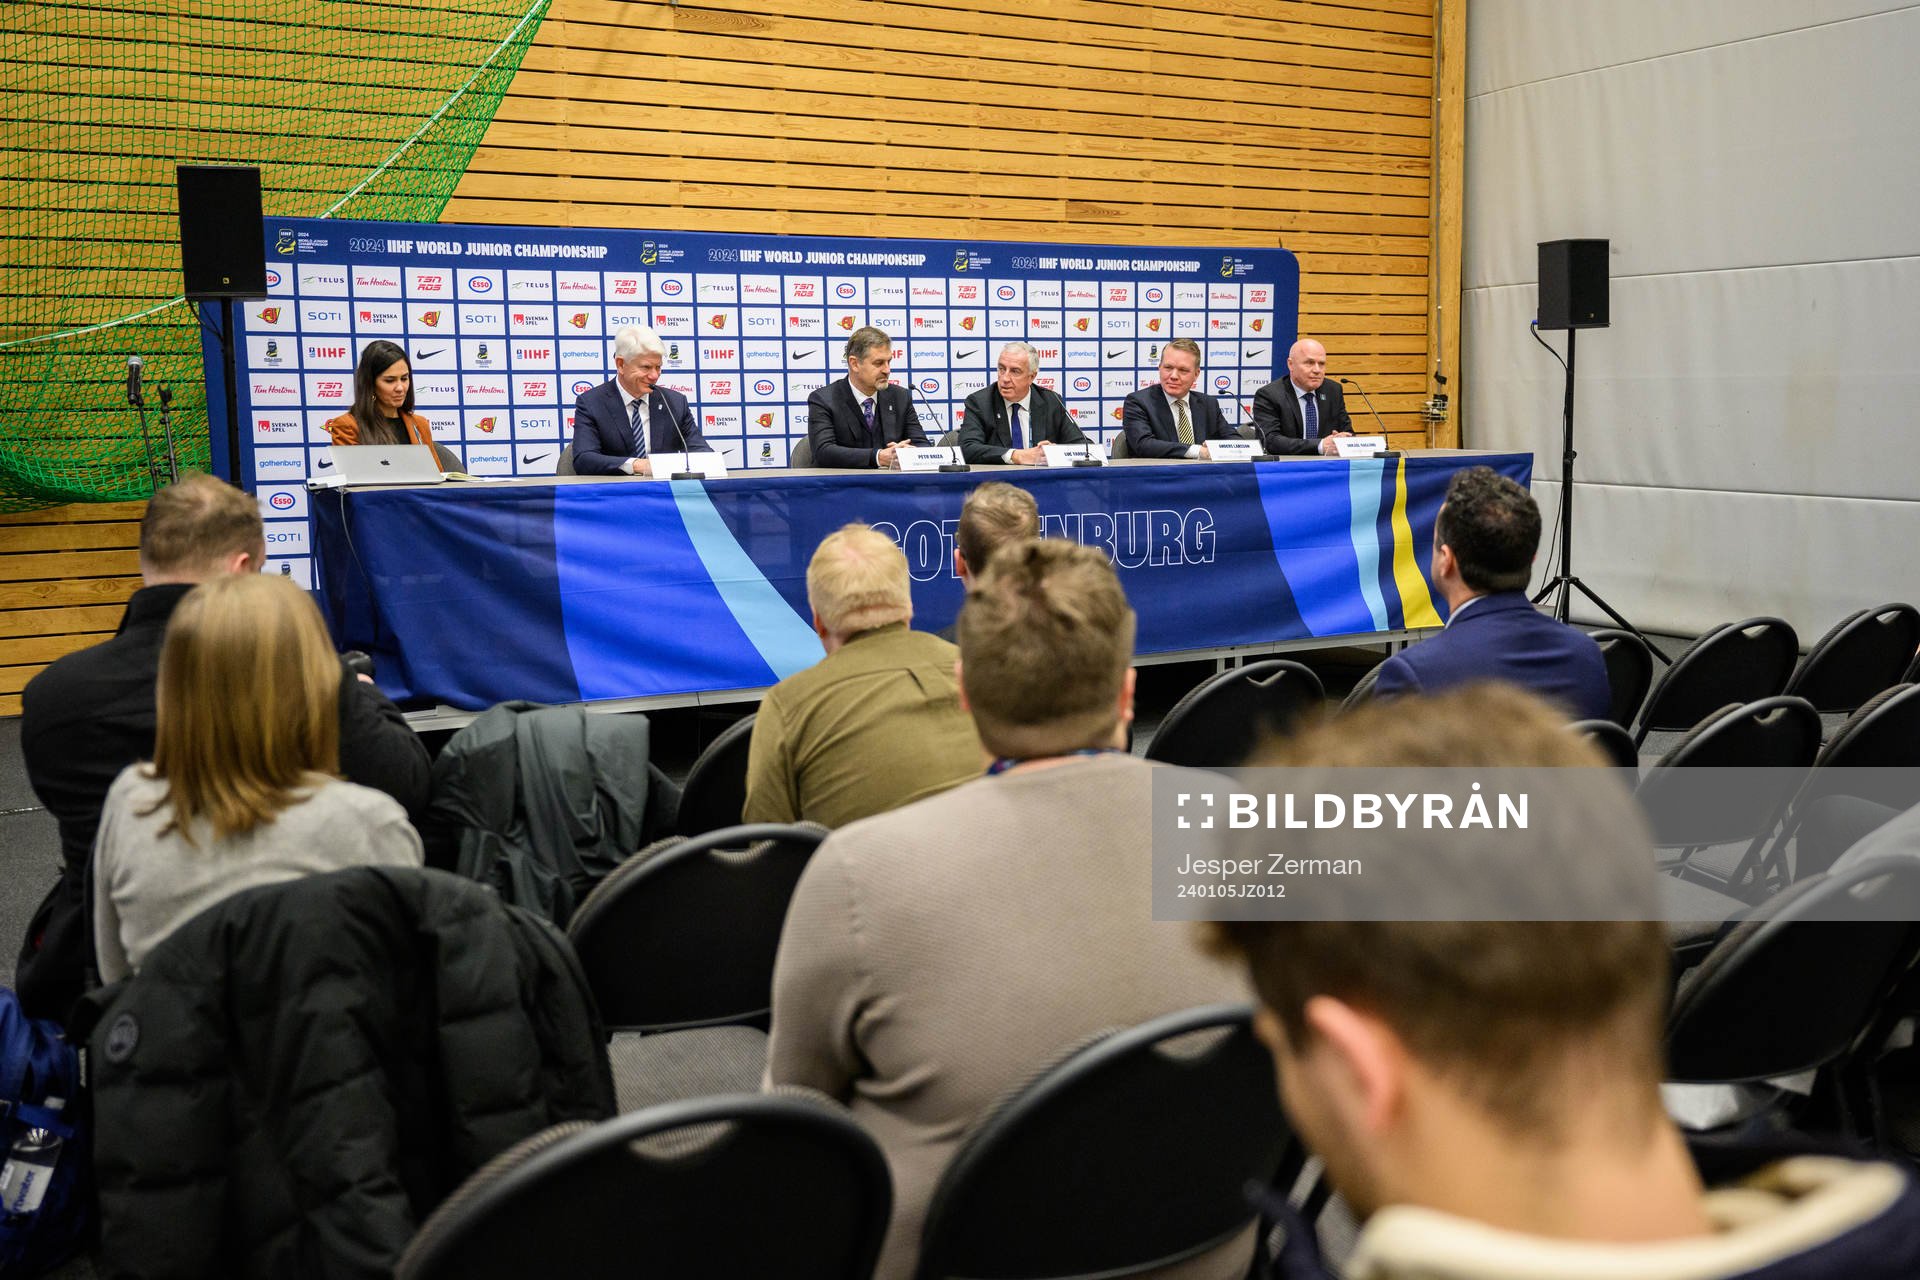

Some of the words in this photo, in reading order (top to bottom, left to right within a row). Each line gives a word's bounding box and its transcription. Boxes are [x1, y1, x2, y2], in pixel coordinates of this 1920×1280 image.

[350, 239, 384, 252] 2024
[387, 240, 412, 254] IIHF
[416, 241, 462, 255] WORLD
[465, 242, 512, 256] JUNIOR
[515, 243, 608, 259] CHAMPIONSHIP
[709, 250, 738, 261] 2024
[740, 250, 761, 262] IIHF
[764, 251, 802, 263] WORLD
[806, 252, 844, 264] JUNIOR
[847, 254, 926, 266] CHAMPIONSHIP
[1012, 257, 1037, 269] 2024
[1039, 258, 1057, 269] IIHF
[1060, 259, 1093, 269] WORLD
[1096, 260, 1129, 270] JUNIOR
[1131, 260, 1200, 271] CHAMPIONSHIP
[356, 277, 368, 286] Tim
[370, 278, 397, 286] Hortons
[560, 282, 570, 290] Tim
[755, 285, 777, 293] Hortons
[308, 312, 341, 320] SOTI
[466, 315, 496, 323] SOTI
[317, 348, 345, 358] IIHF
[525, 350, 549, 359] IIHF
[562, 351, 598, 359] gothenburg
[710, 350, 734, 359] IIHF
[746, 351, 779, 359] gothenburg
[253, 385, 267, 394] Tim
[268, 386, 297, 394] Hortons
[466, 386, 478, 394] Tim
[480, 386, 505, 394] Hortons
[520, 420, 550, 428] SOTI
[260, 460, 301, 468] gothenburg
[470, 456, 508, 464] gothenburg
[267, 533, 300, 542] SOTI
